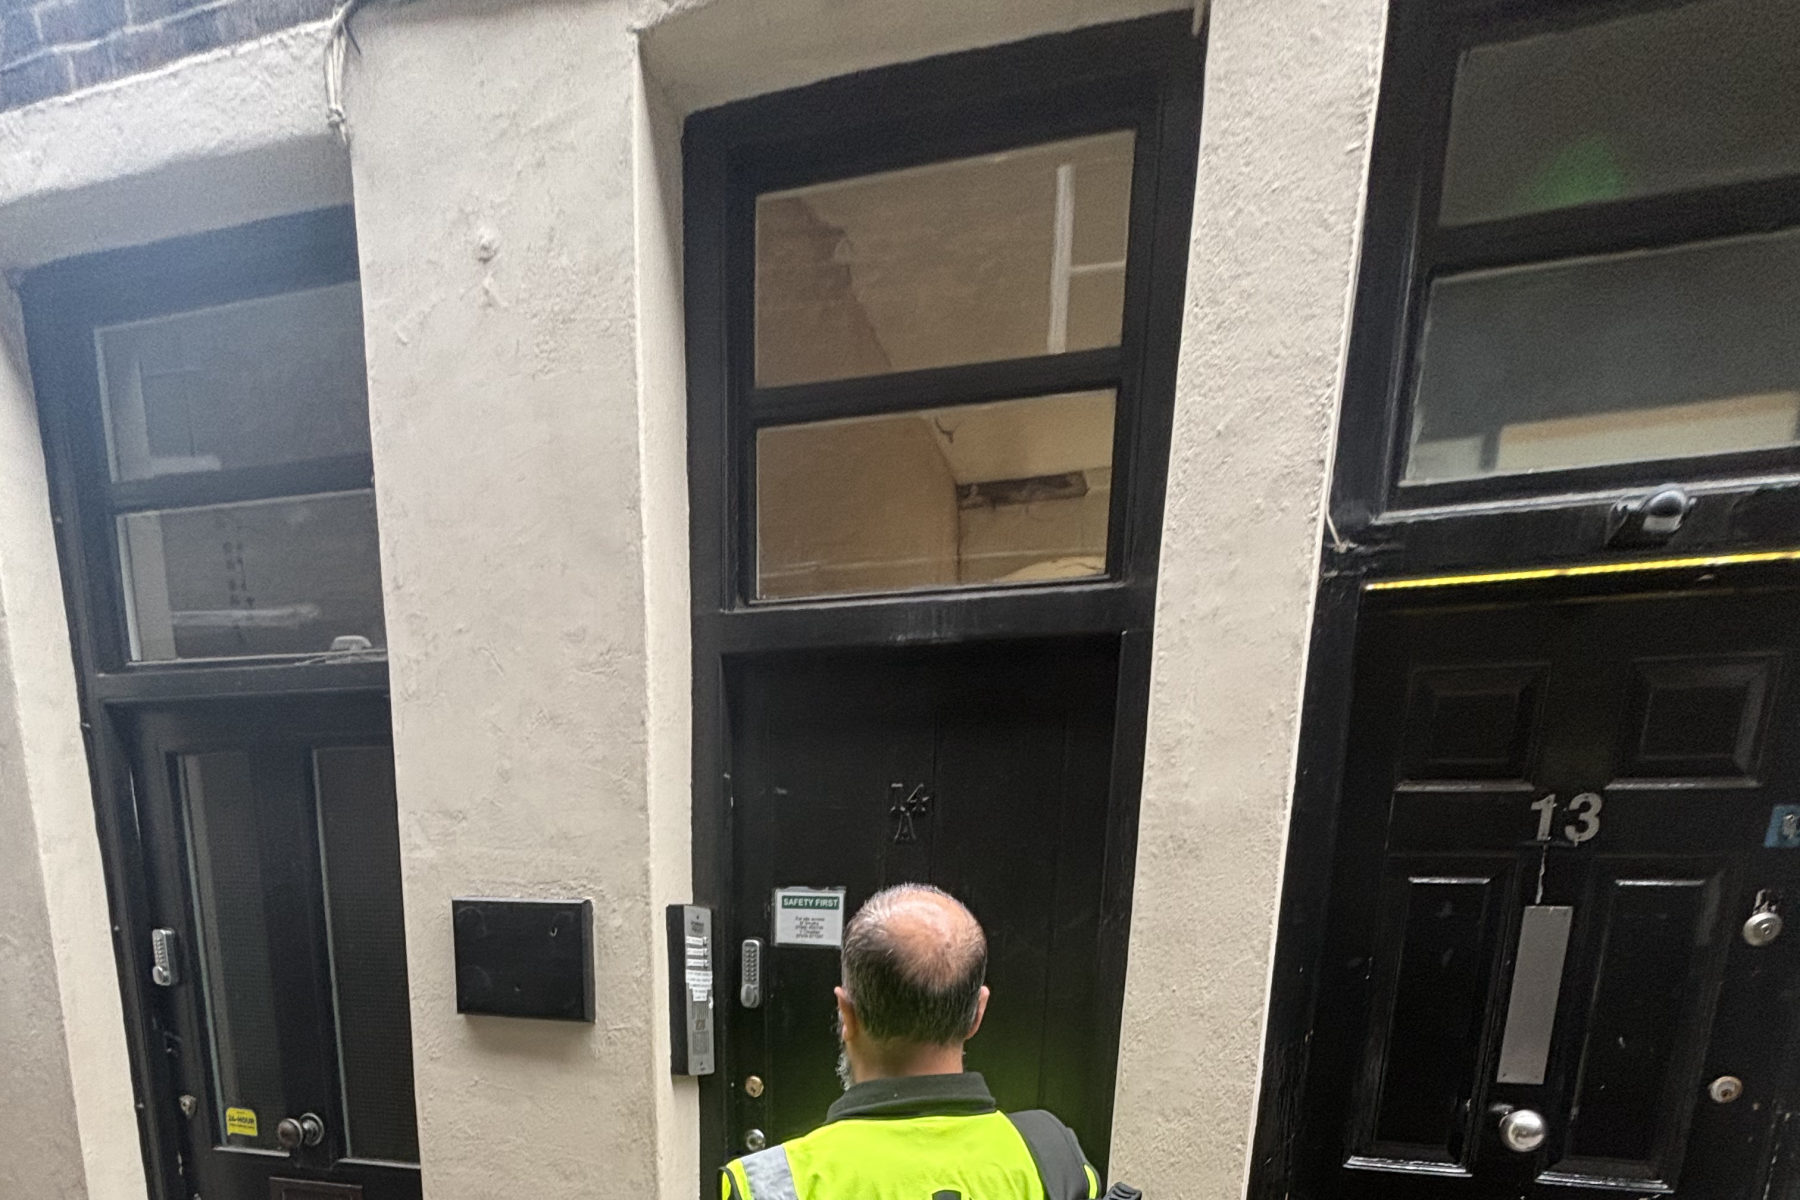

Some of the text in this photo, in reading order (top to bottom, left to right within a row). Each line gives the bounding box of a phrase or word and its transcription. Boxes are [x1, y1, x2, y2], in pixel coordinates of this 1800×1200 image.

[1530, 792, 1602, 843] 13
[783, 898, 839, 908] SAFETY FIRST
